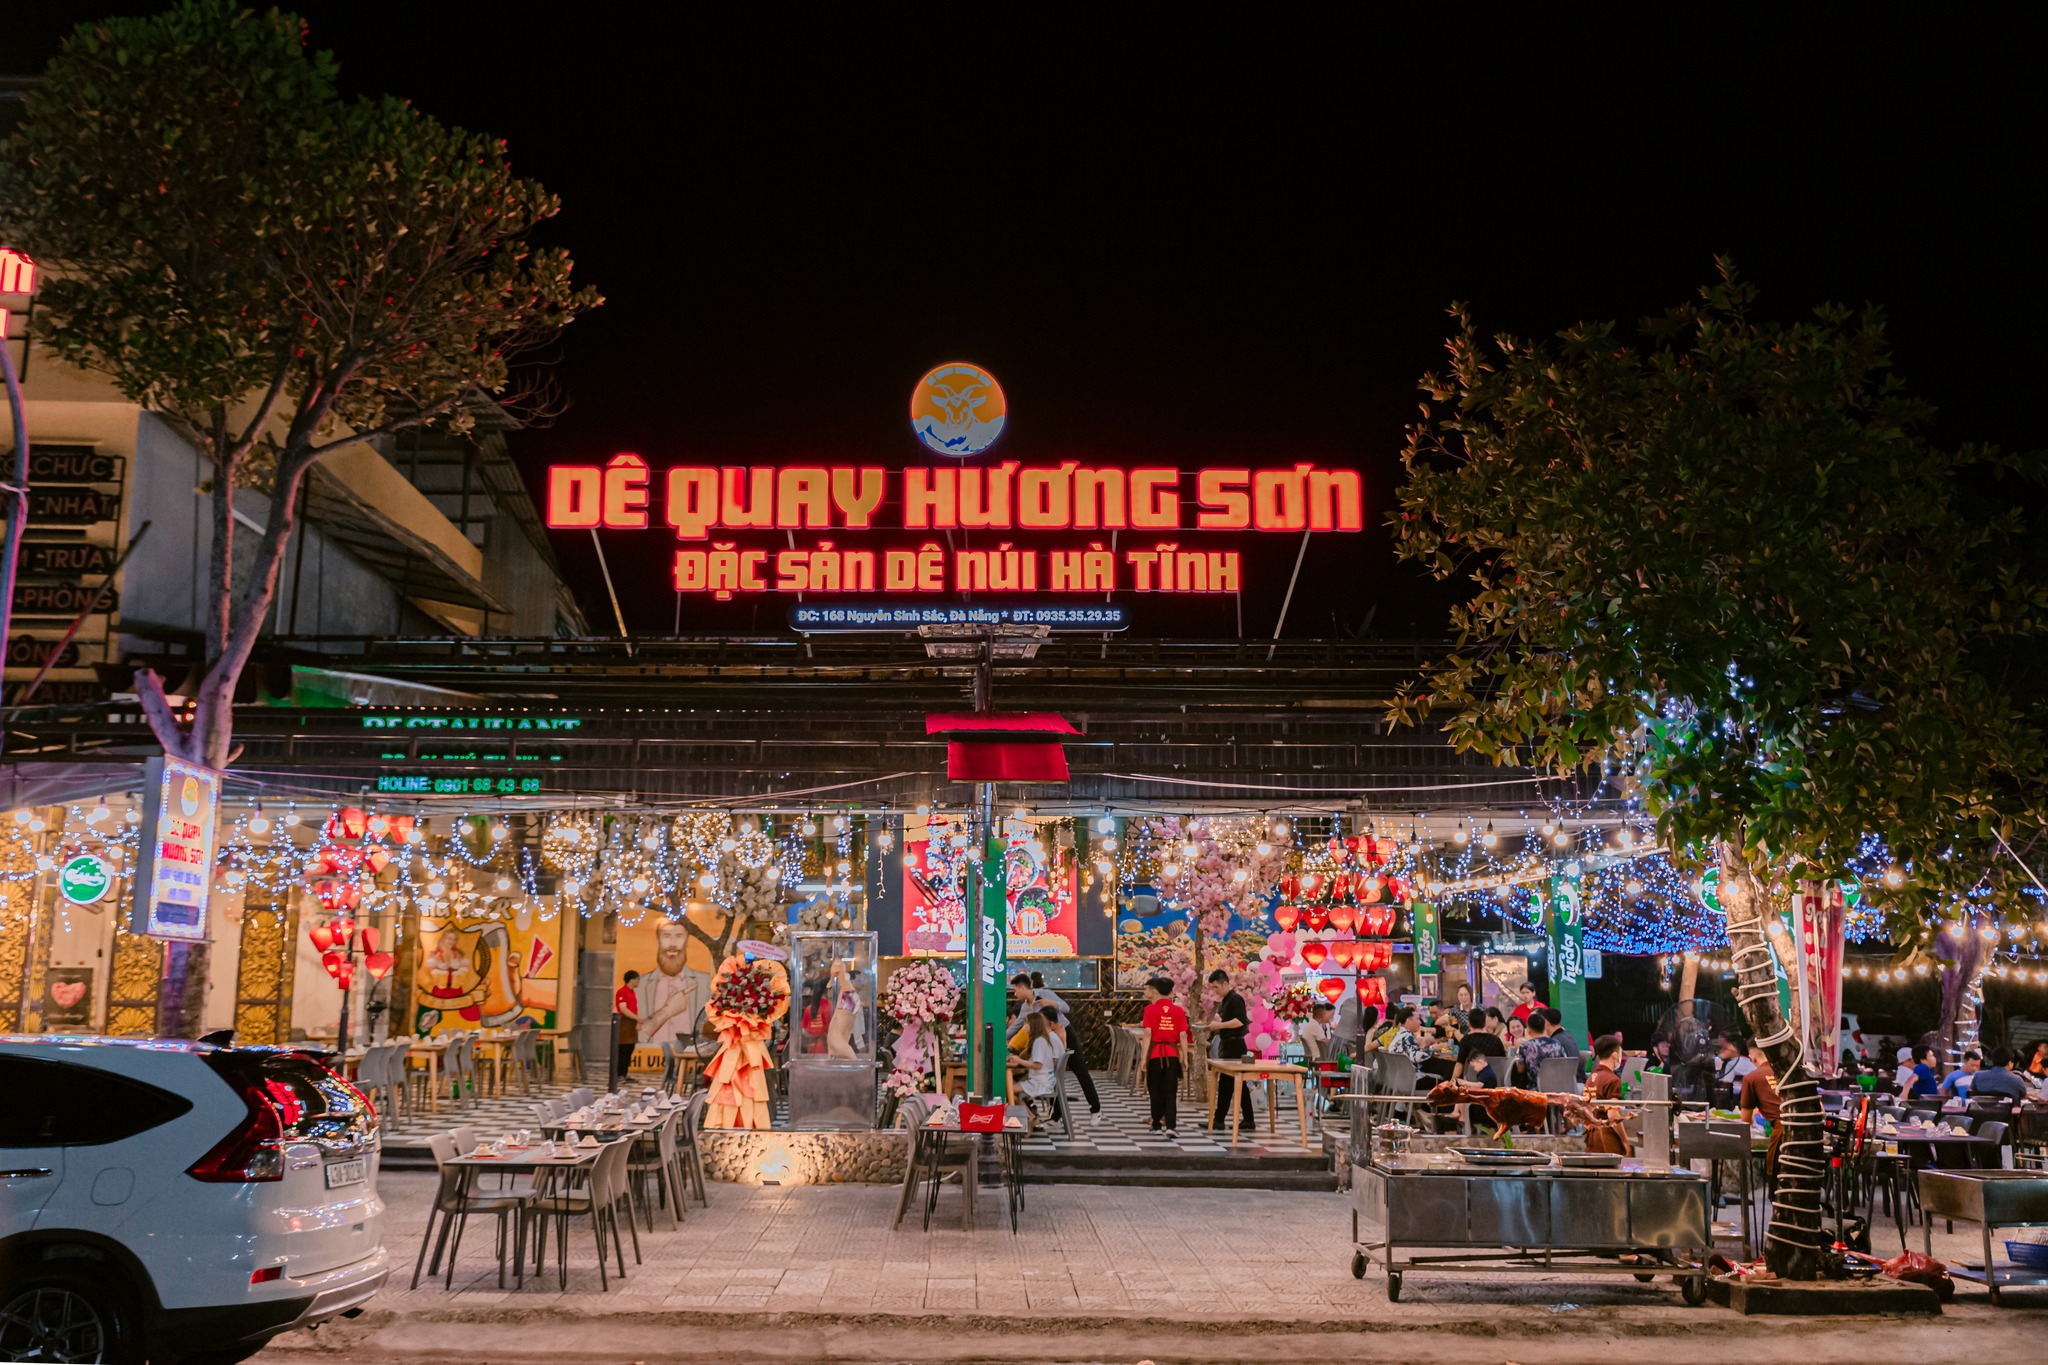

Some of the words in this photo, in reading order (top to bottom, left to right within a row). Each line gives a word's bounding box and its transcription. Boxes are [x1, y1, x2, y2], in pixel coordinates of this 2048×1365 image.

[546, 453, 650, 529] DÊ
[665, 465, 886, 540] QUAY
[903, 460, 1180, 530] HƯƠNG
[1197, 463, 1363, 532] SƠN
[674, 542, 767, 600] ĐẶC
[776, 541, 875, 592] SẢN
[885, 543, 943, 592] DÊ
[955, 542, 1037, 592] NÚI
[1050, 542, 1115, 592] HÀ
[1126, 543, 1240, 593] TĨNH
[798, 610, 820, 622] ĐC:
[822, 610, 845, 621] 168
[893, 610, 920, 621] Sinh
[949, 610, 966, 621] Đà
[1013, 610, 1034, 622] ĐT:
[1036, 610, 1121, 622] 0935.35.29.35
[377, 776, 431, 791] HOLINE:
[434, 778, 468, 792] 0901
[472, 778, 491, 791] 68
[496, 779, 515, 791] 43
[520, 778, 540, 791] 68
[1417, 928, 1437, 967] huda
[1558, 933, 1583, 984] huda
